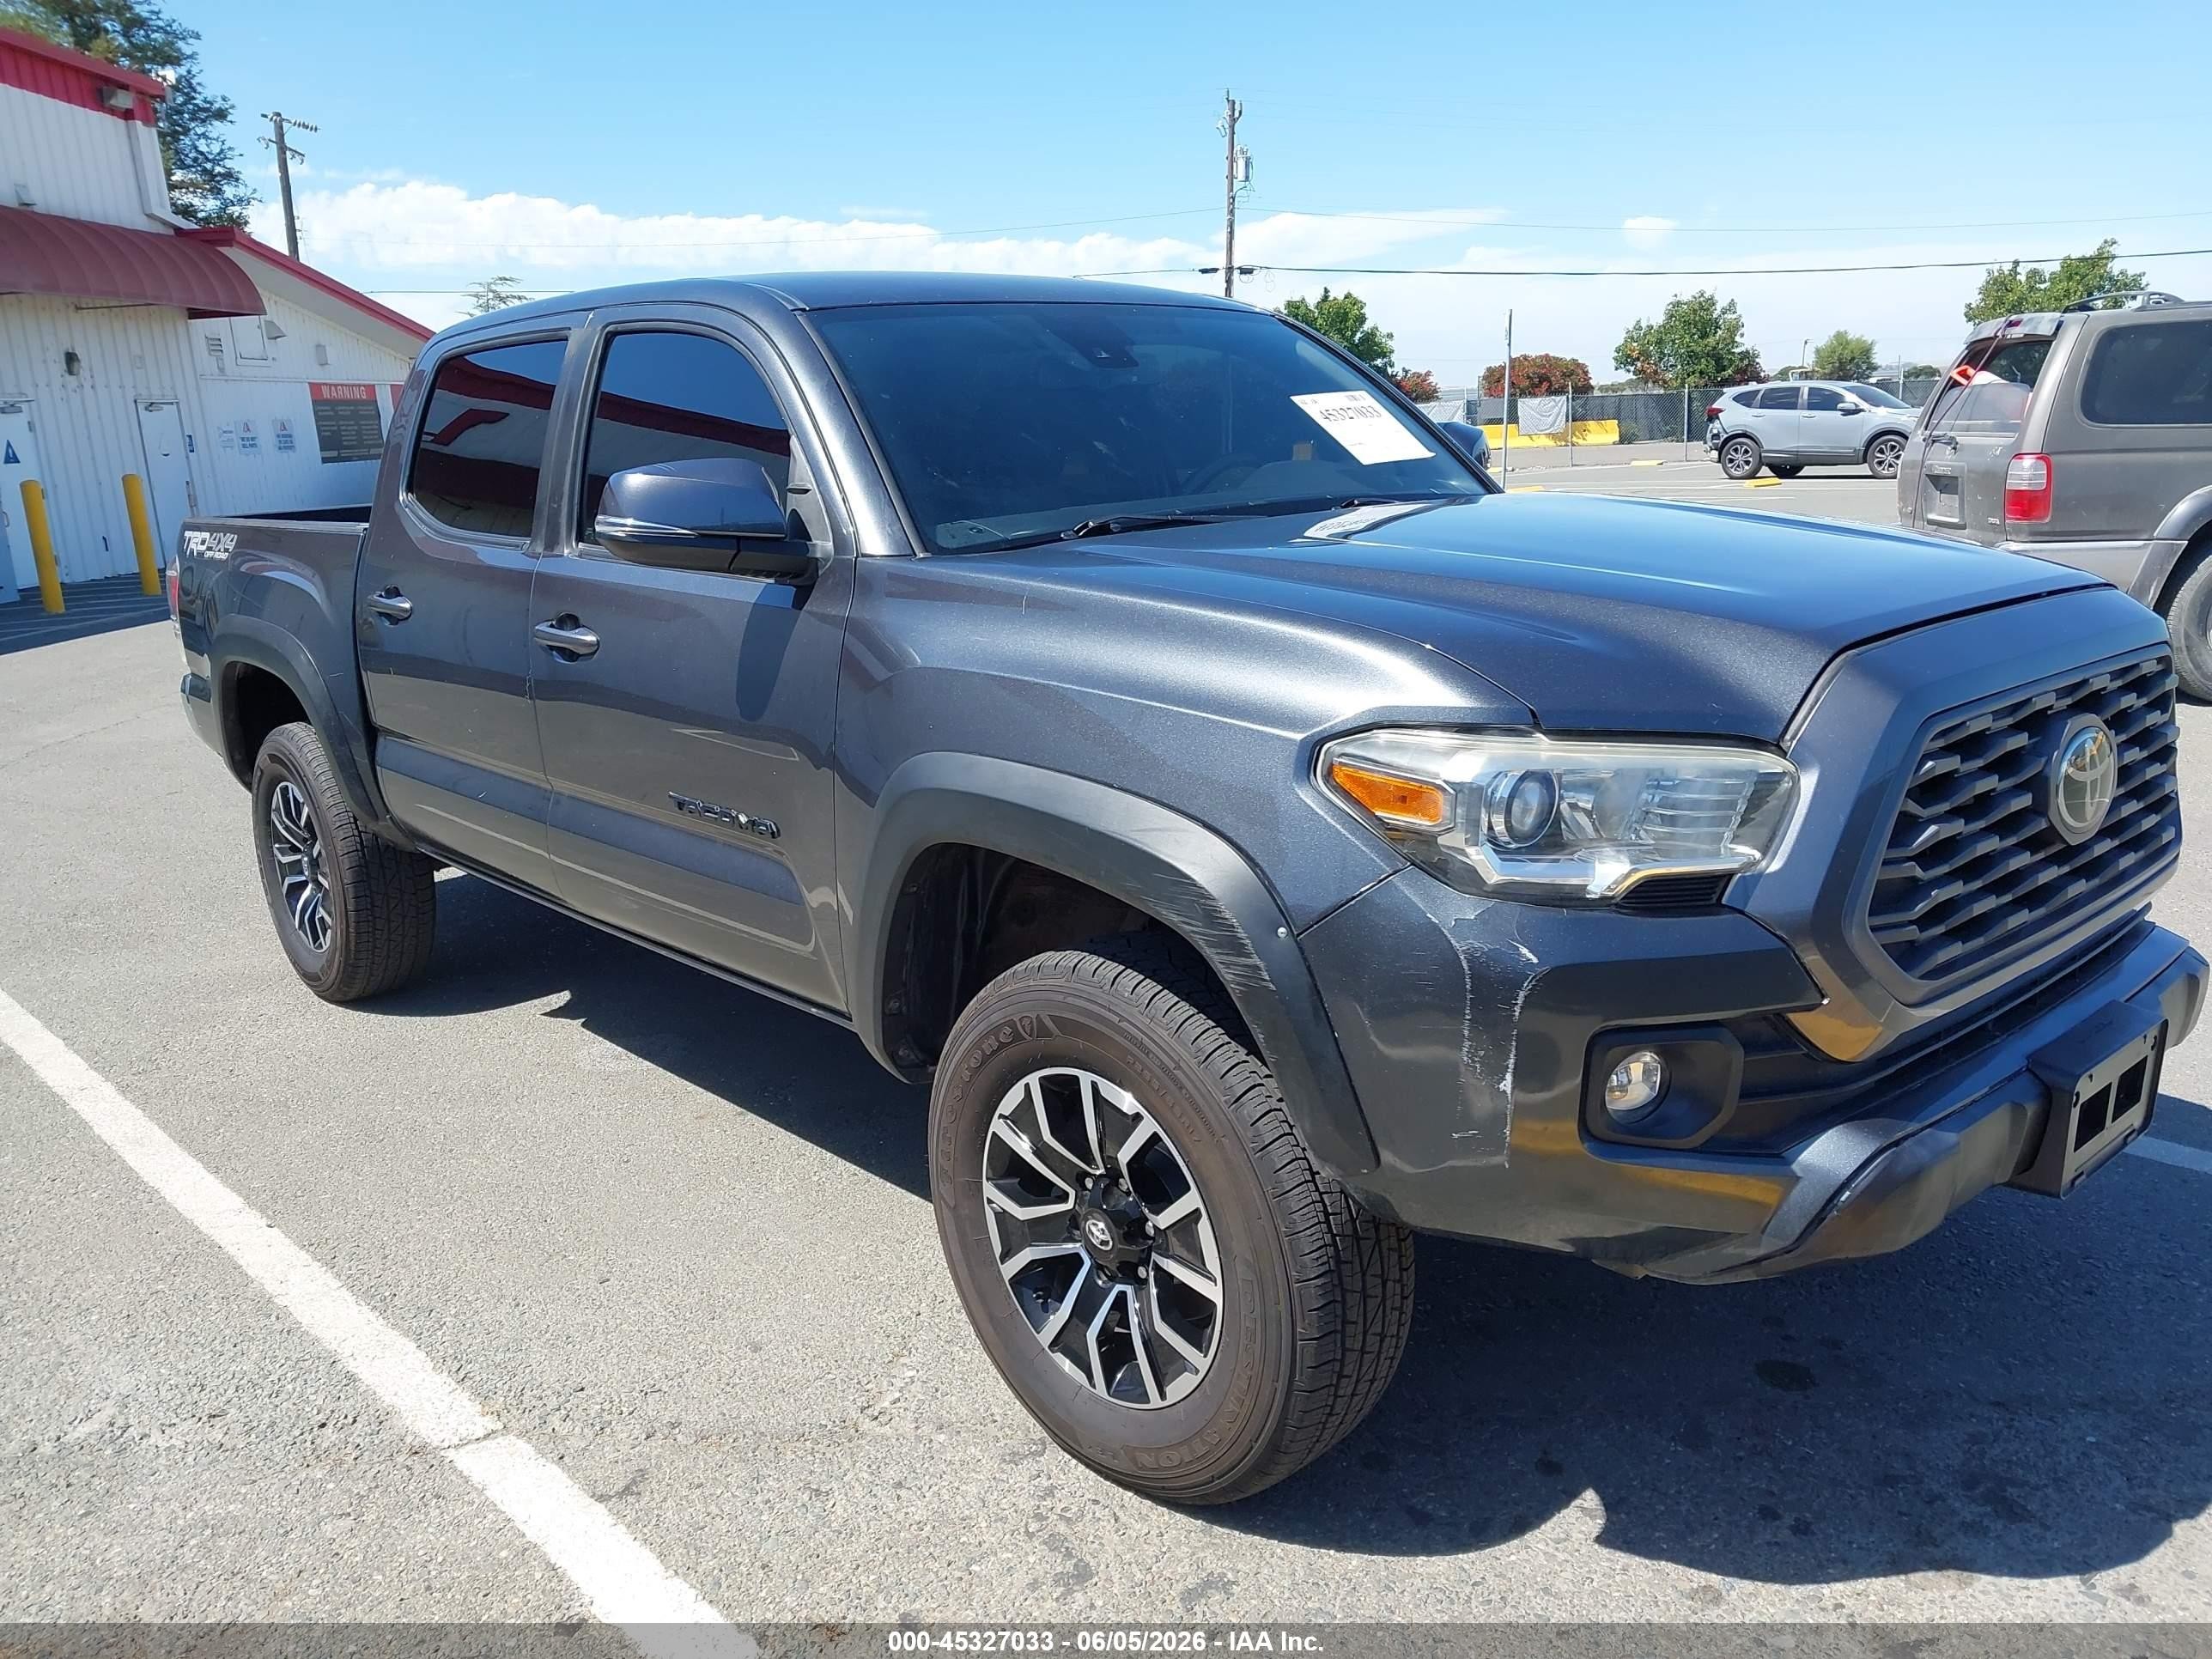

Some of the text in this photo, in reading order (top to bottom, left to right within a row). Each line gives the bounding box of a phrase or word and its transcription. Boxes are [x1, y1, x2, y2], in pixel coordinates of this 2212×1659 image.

[321, 385, 367, 399] WARNING
[1319, 404, 1382, 422] 45327033
[183, 530, 210, 558] TRD
[667, 790, 781, 839] TACOMA
